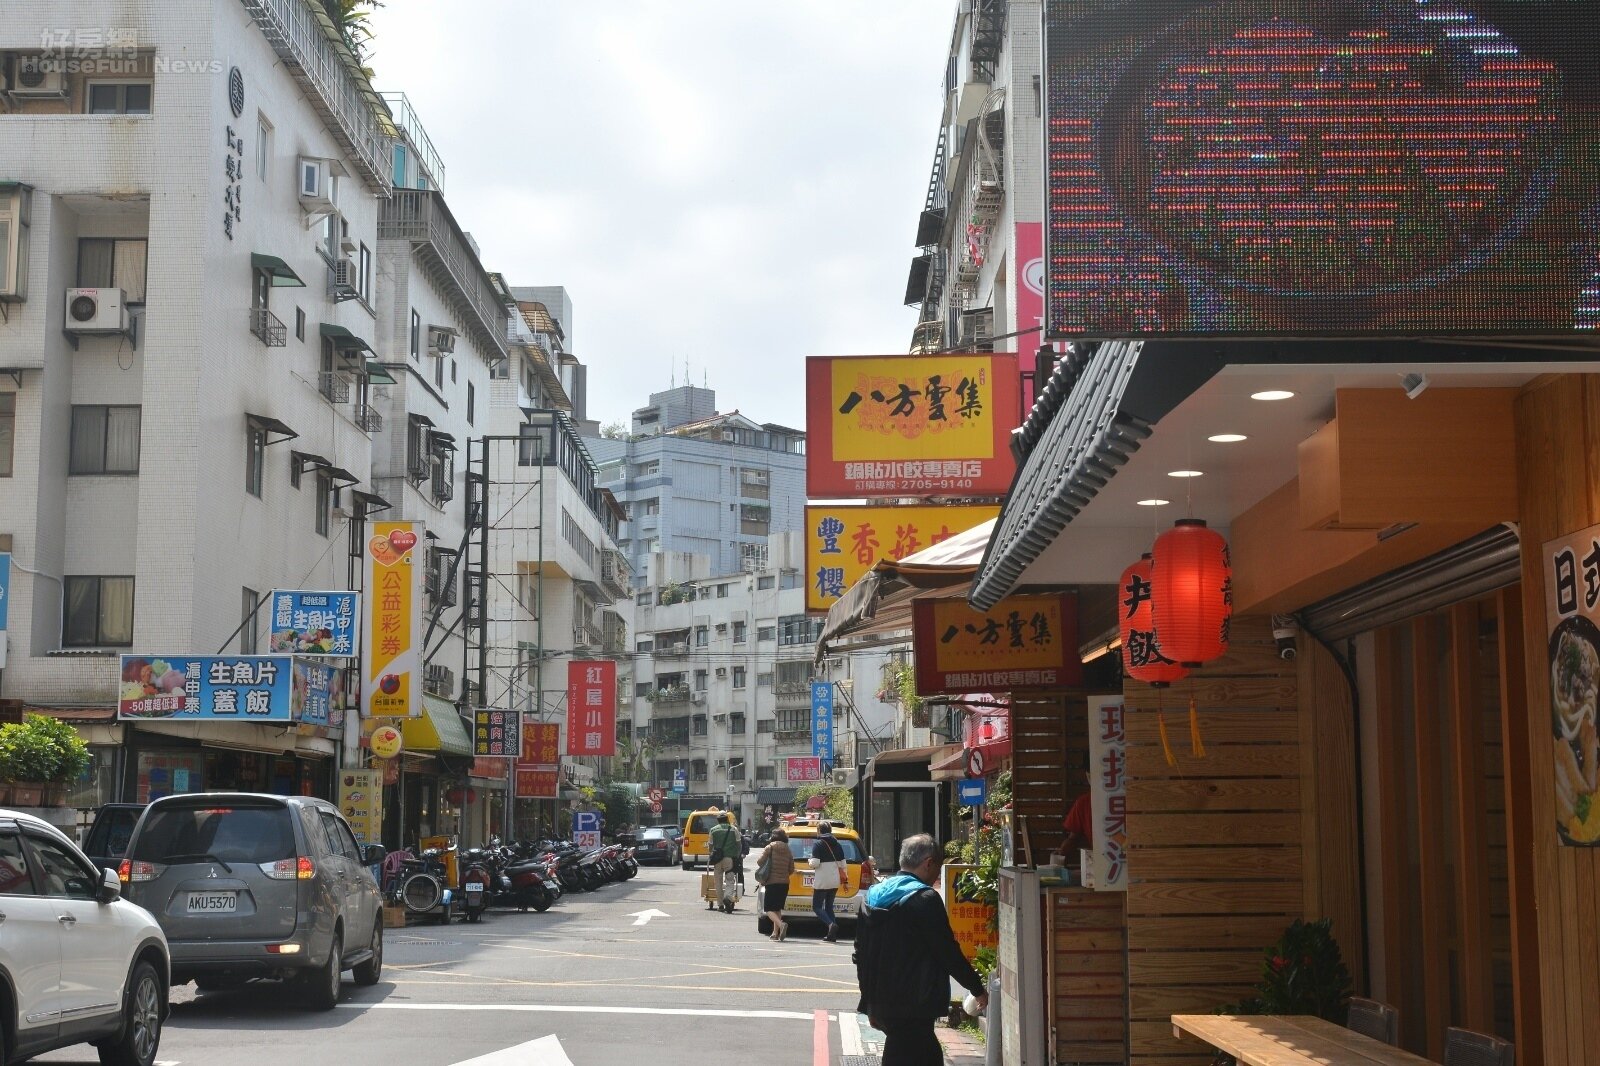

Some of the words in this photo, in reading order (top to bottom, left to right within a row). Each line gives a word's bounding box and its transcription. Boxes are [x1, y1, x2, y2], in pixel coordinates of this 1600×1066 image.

[839, 375, 983, 422] 八方雲集
[844, 460, 982, 479] 鍋貼水餃專賣店
[277, 595, 293, 628] 蓋飯
[294, 610, 337, 631] 生魚片
[381, 571, 401, 656] 公益彩券
[941, 611, 1053, 649] 八方雲集
[209, 661, 277, 685] 生魚片
[945, 670, 1057, 688] 鍋貼水餃專賣店
[213, 690, 270, 714] 蓋飯
[585, 667, 603, 749] 紅屋小廚
[580, 834, 595, 846] 25
[188, 895, 237, 910] AKU-5370
